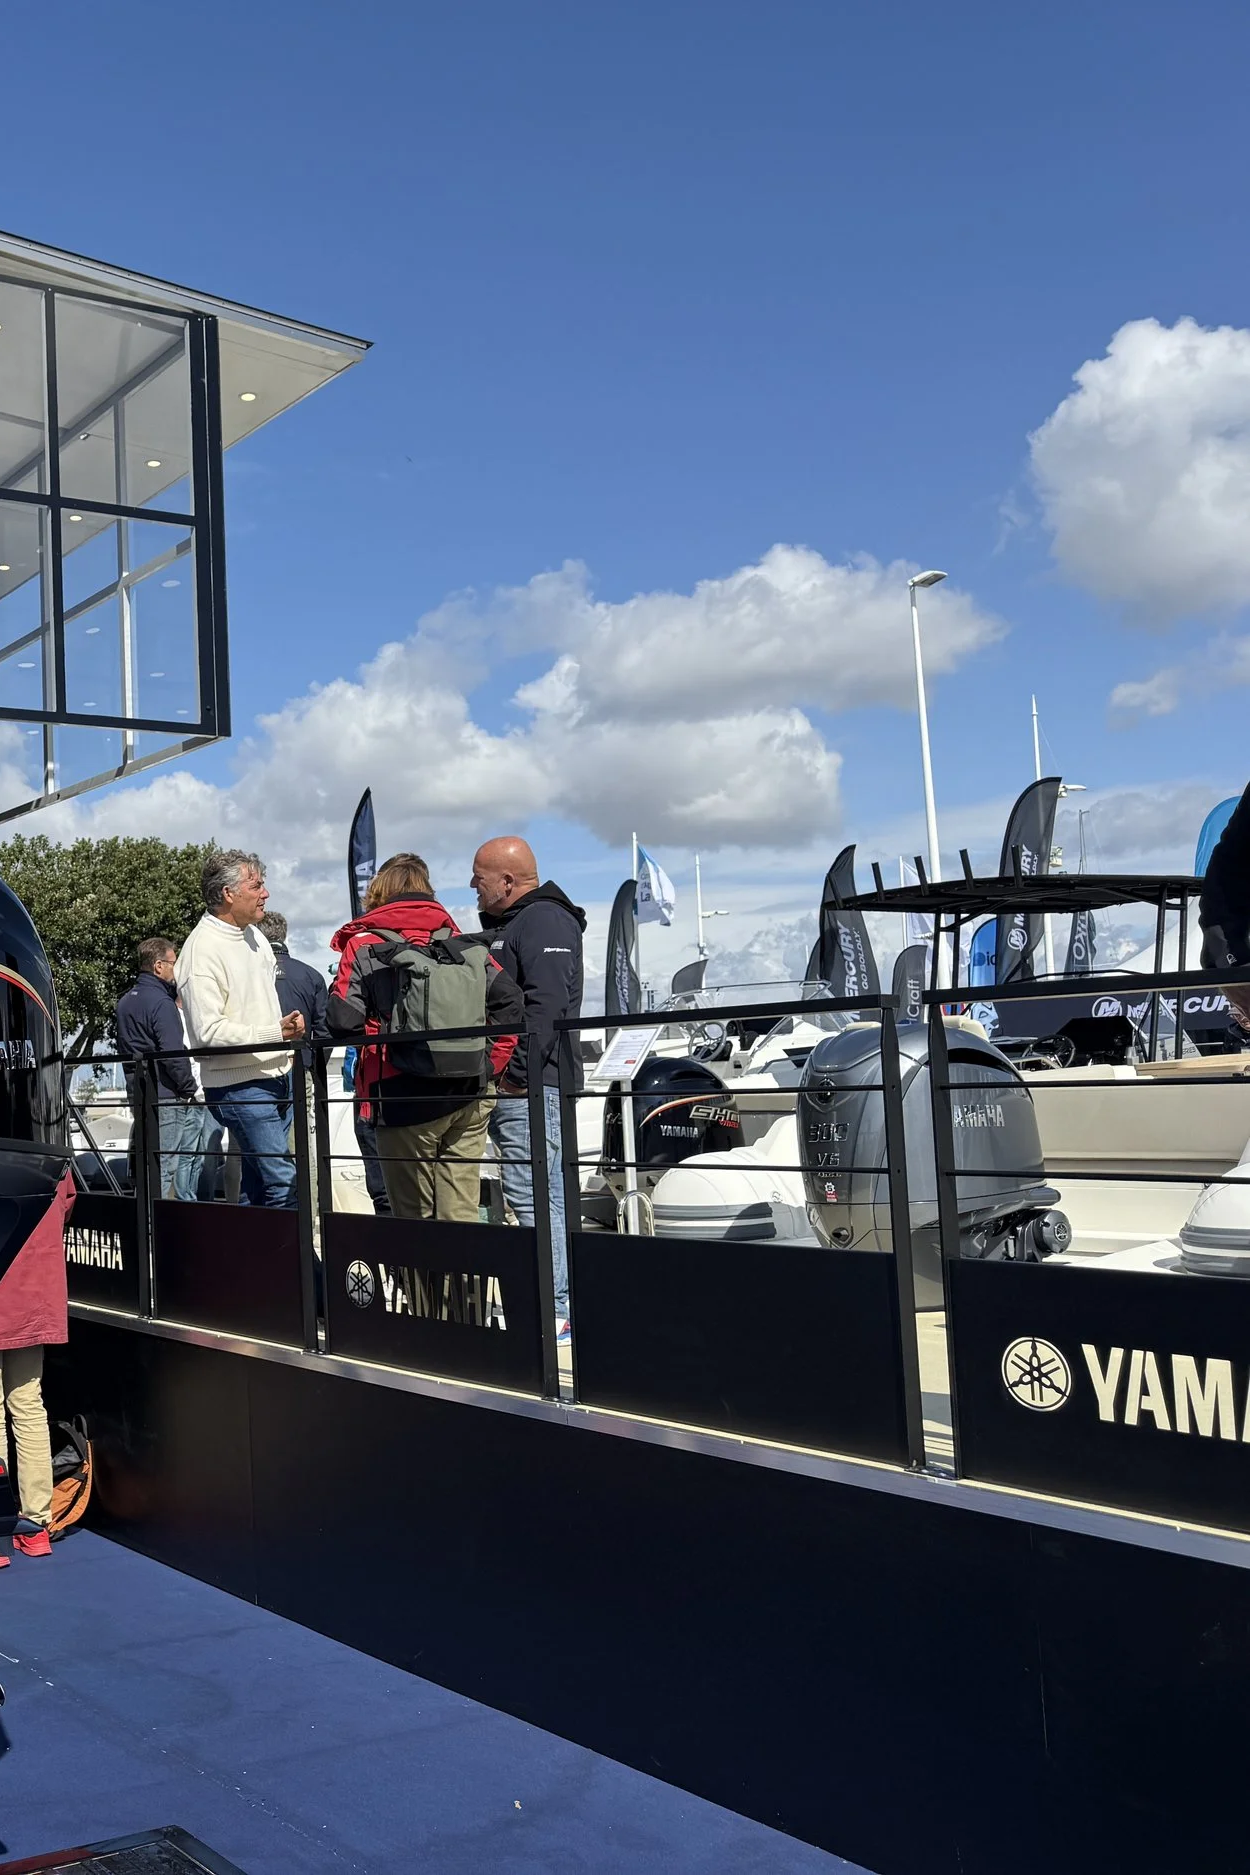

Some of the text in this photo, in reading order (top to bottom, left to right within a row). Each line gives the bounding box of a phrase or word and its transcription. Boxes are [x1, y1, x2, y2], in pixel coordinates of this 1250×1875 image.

[837, 919, 860, 1020] ERCURY
[660, 1124, 699, 1138] YAMAHA
[953, 1104, 1005, 1128] AMAHA
[63, 1227, 123, 1271] AMAHA
[378, 1263, 507, 1331] YAMAHA
[1081, 1343, 1250, 1444] YAM
